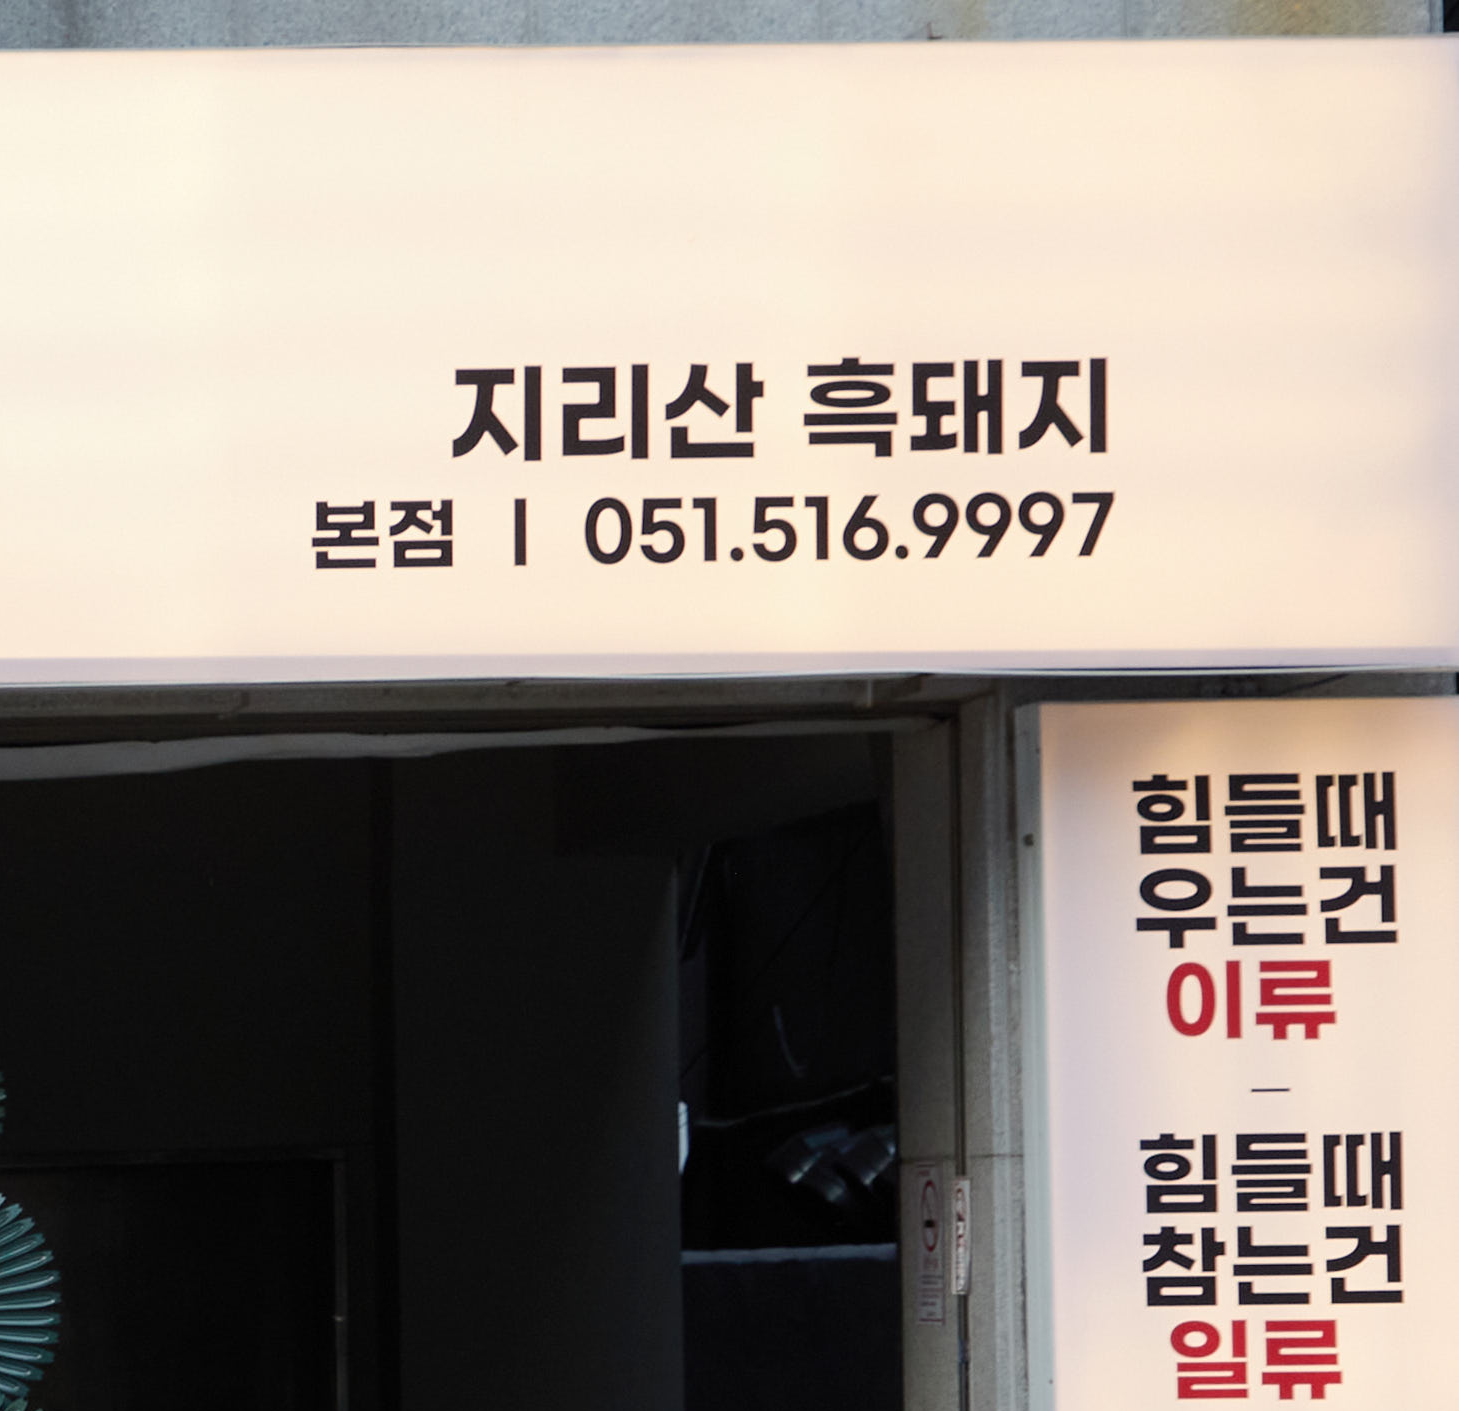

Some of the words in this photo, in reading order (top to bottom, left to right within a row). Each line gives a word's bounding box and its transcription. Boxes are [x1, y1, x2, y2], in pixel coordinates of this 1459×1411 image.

[453, 361, 763, 461] 지리산
[804, 356, 1108, 457] 흑돼지
[312, 500, 453, 569] 본점
[585, 491, 1114, 565] 051.516.9997
[1132, 771, 1397, 855] 힘들때
[1136, 865, 1398, 949] 우는건
[1166, 960, 1336, 1040] 이류
[1140, 1131, 1403, 1214] 힘들때
[1142, 1225, 1403, 1307] 참는건
[1170, 1320, 1342, 1400] 일류
